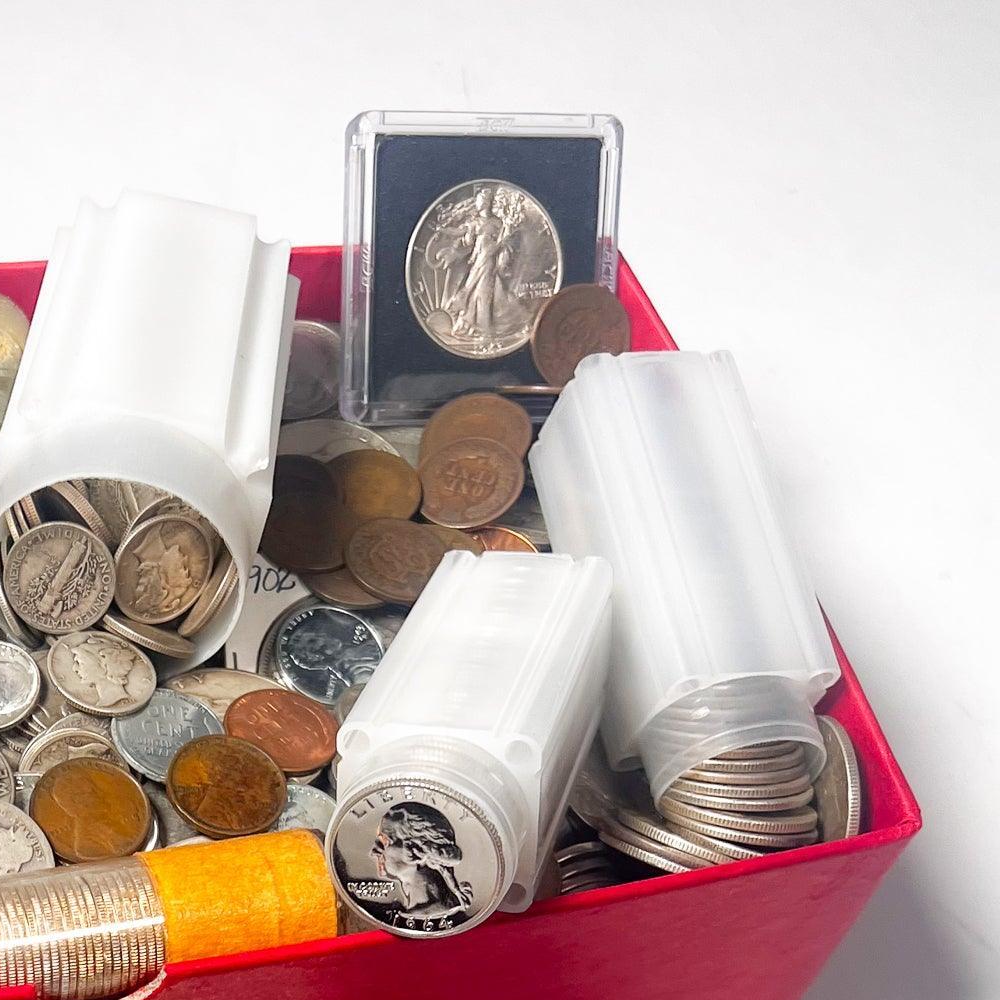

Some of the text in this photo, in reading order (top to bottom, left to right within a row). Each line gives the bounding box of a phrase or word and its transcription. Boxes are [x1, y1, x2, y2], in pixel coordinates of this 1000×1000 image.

[10, 546, 30, 594] AMERICA
[31, 611, 76, 630] STATES
[75, 592, 109, 626] UNITED
